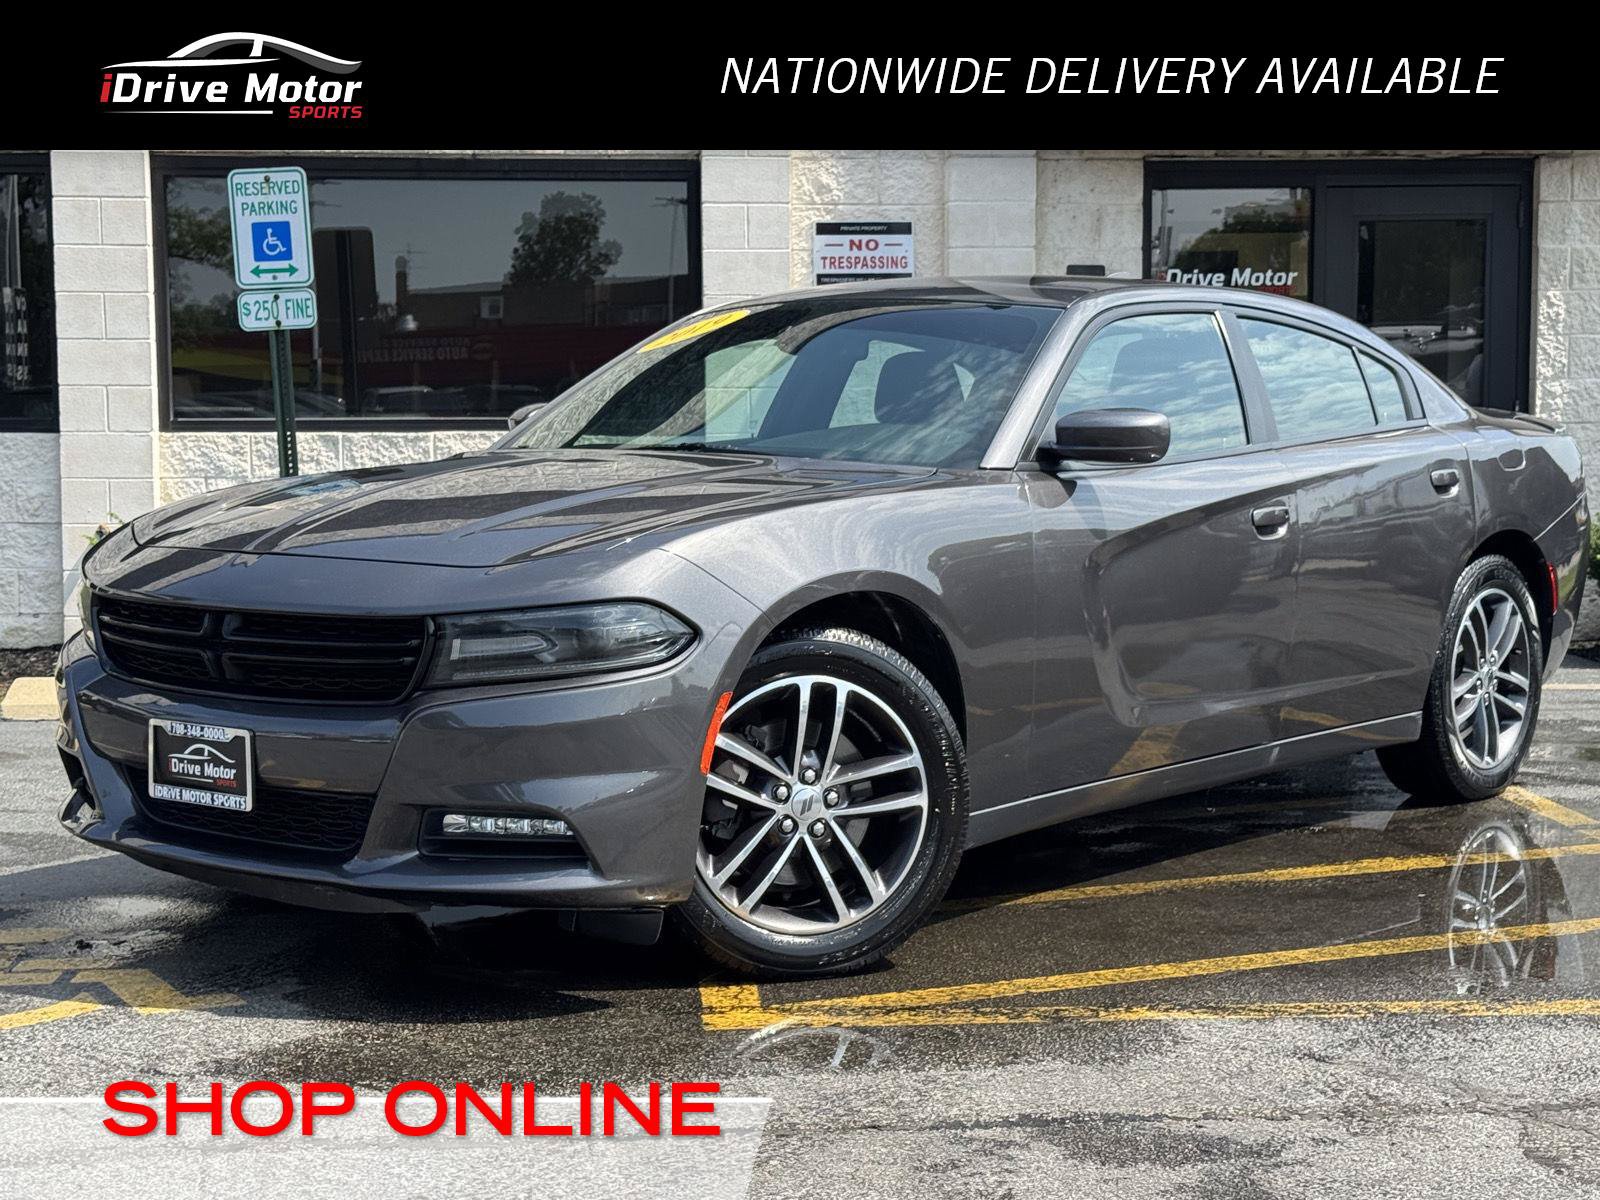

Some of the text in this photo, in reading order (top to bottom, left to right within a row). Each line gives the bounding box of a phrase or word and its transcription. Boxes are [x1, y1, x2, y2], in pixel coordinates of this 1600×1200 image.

[235, 180, 300, 197] RESERVED
[241, 200, 298, 216] PARKING
[849, 239, 879, 251] NO
[821, 256, 908, 269] TRESPASSING
[1230, 267, 1298, 287] Motor
[242, 298, 313, 321] $250 FINE
[171, 722, 224, 740] 708-348-0000
[204, 762, 237, 780] Motor
[182, 788, 212, 805] MOTOR
